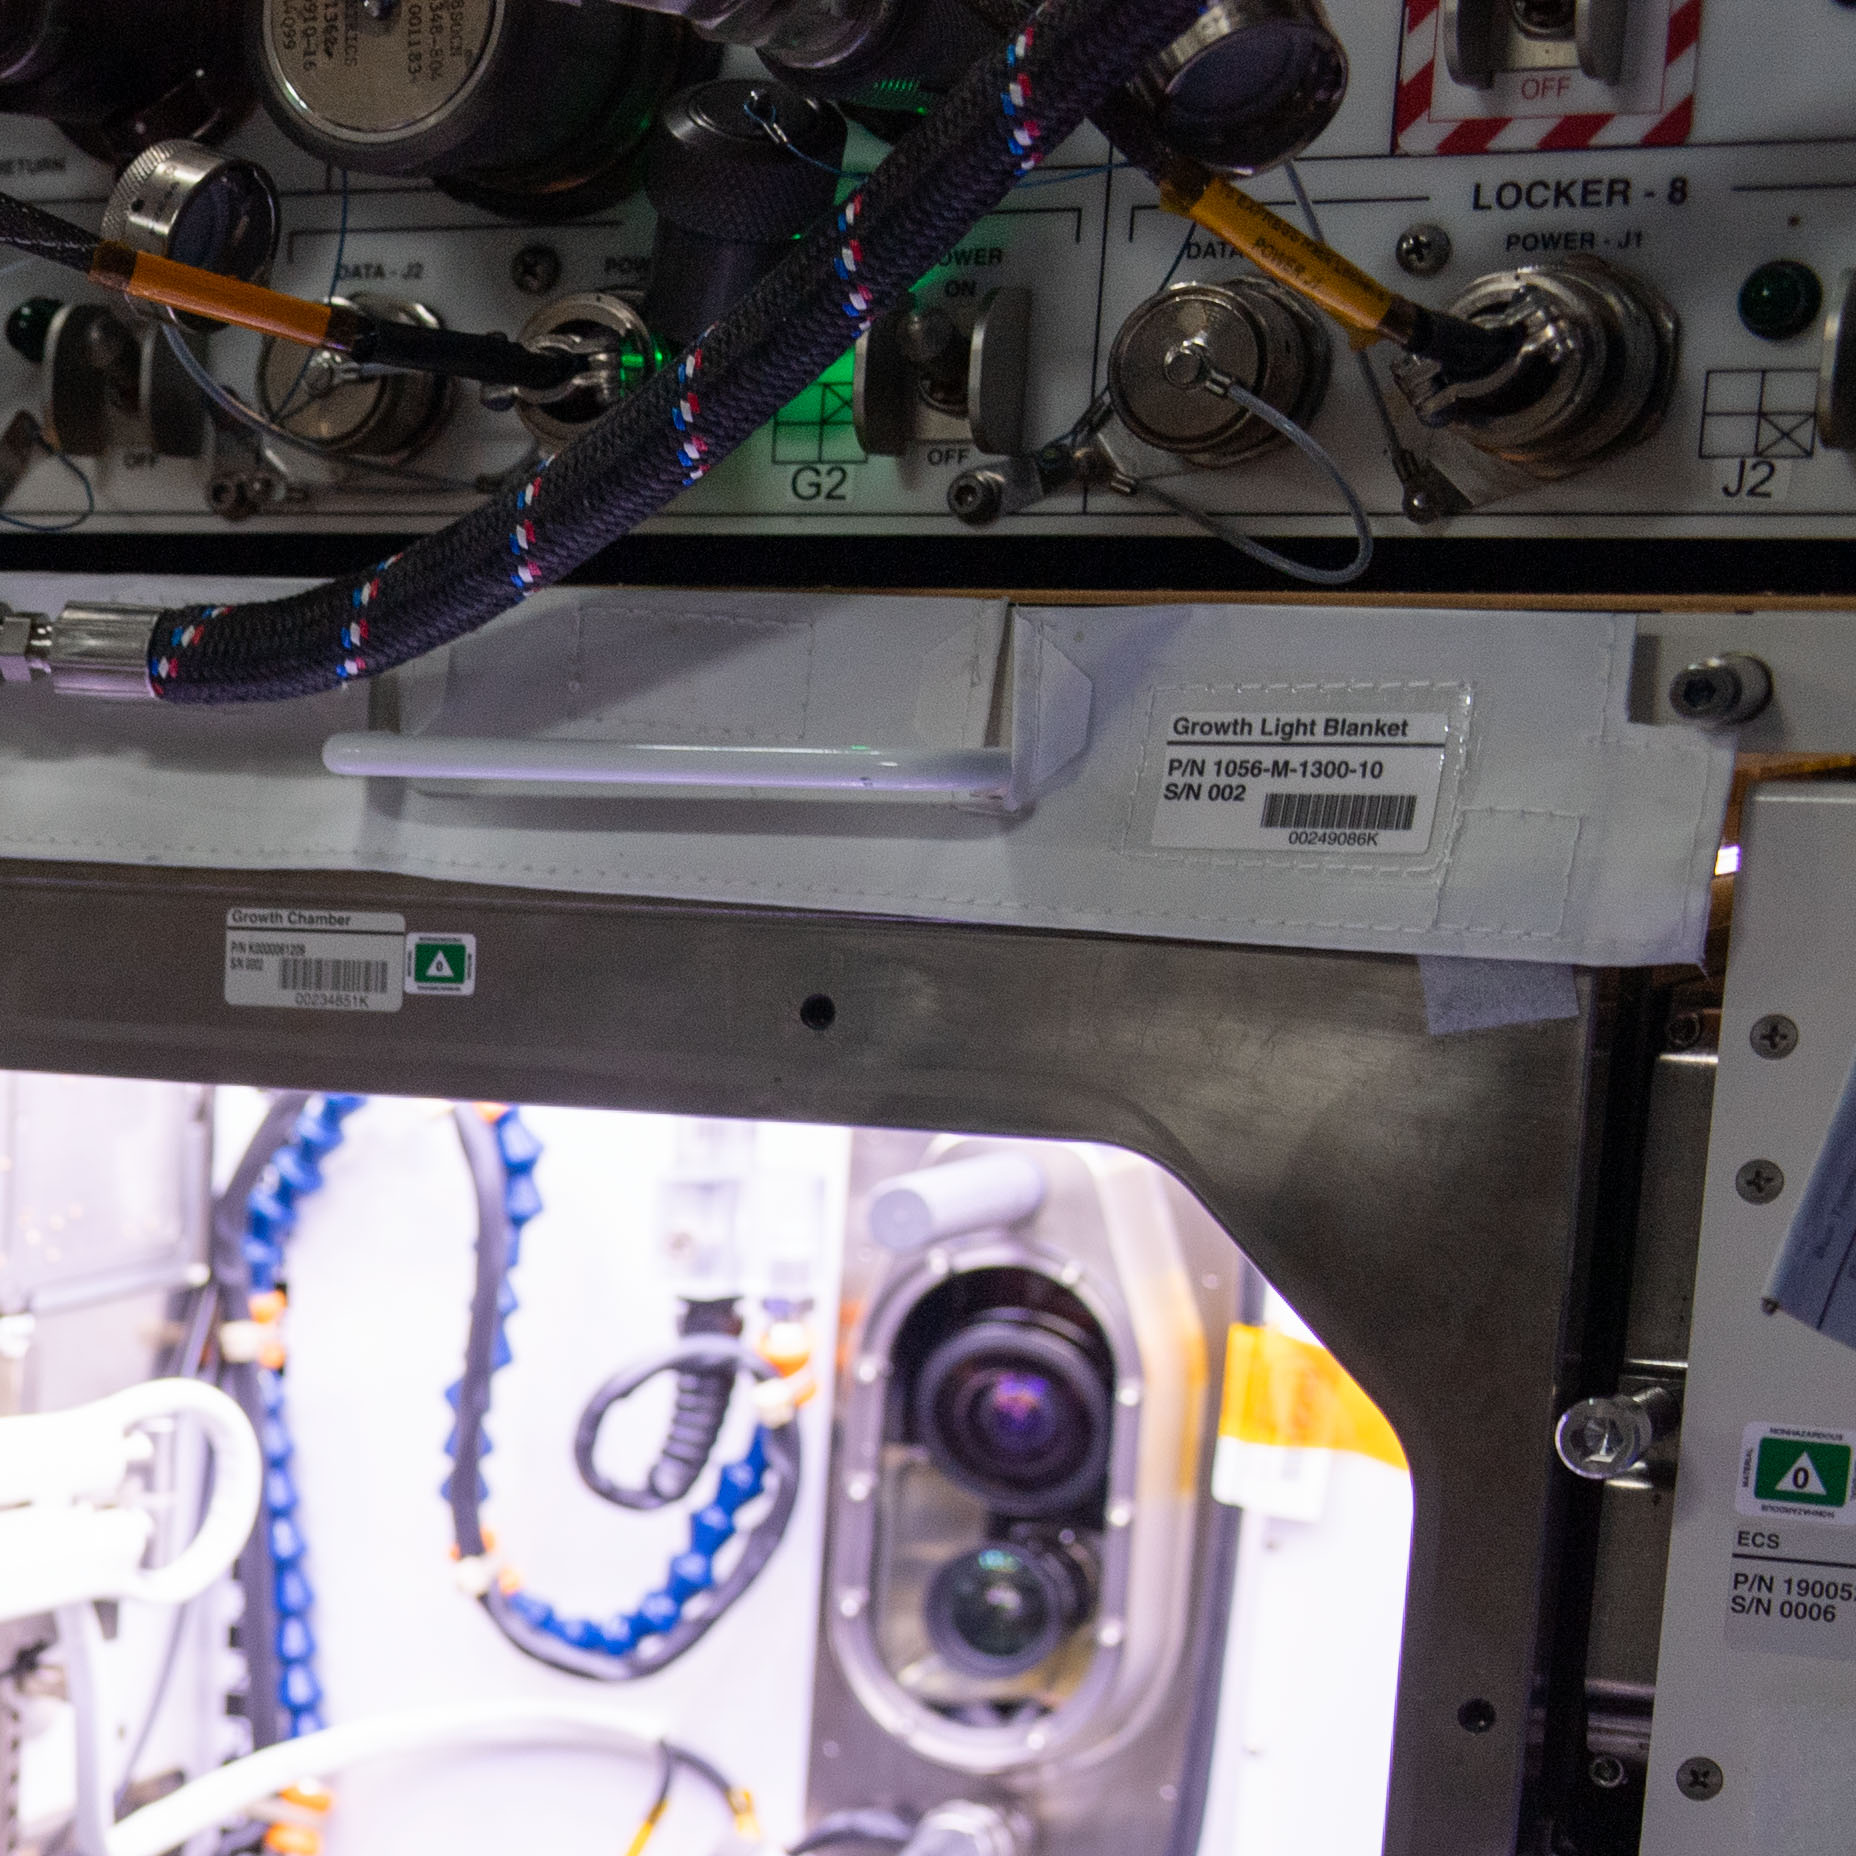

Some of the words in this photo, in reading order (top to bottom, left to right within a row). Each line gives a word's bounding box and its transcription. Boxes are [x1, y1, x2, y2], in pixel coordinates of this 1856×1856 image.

[1520, 76, 1572, 101] OFF
[1472, 177, 1632, 212] LOCKER
[1666, 176, 1689, 206] 8
[1505, 231, 1596, 252] POWER
[1616, 229, 1642, 250] J1
[604, 256, 653, 275] POW
[938, 249, 1004, 268] OWER
[1252, 234, 1309, 279] POWER
[339, 263, 386, 280] DATA
[944, 280, 977, 298] ON
[927, 449, 971, 468] OFF
[791, 465, 848, 501] G2
[1721, 458, 1777, 498] J2
[1172, 716, 1253, 737] Growth
[1260, 717, 1316, 742] Light
[1323, 718, 1409, 738] Blanket
[1167, 757, 1206, 778] P/N
[1213, 759, 1384, 780] 1056-M-1300-10
[1163, 783, 1202, 802] S/N
[1206, 783, 1247, 802] 002
[1287, 831, 1379, 847] 00249086K
[231, 907, 284, 925] Growth
[287, 910, 352, 928] Chamber
[435, 960, 444, 973] 0
[1768, 1426, 1844, 1442] NONHAZARDOUS
[1791, 1465, 1810, 1490] 0
[1737, 1530, 1781, 1550] ECS
[1732, 1572, 1775, 1594] P/N
[1783, 1576, 1856, 1604] 19005
[1730, 1594, 1772, 1617] S/N
[1779, 1599, 1837, 1624] 0006
